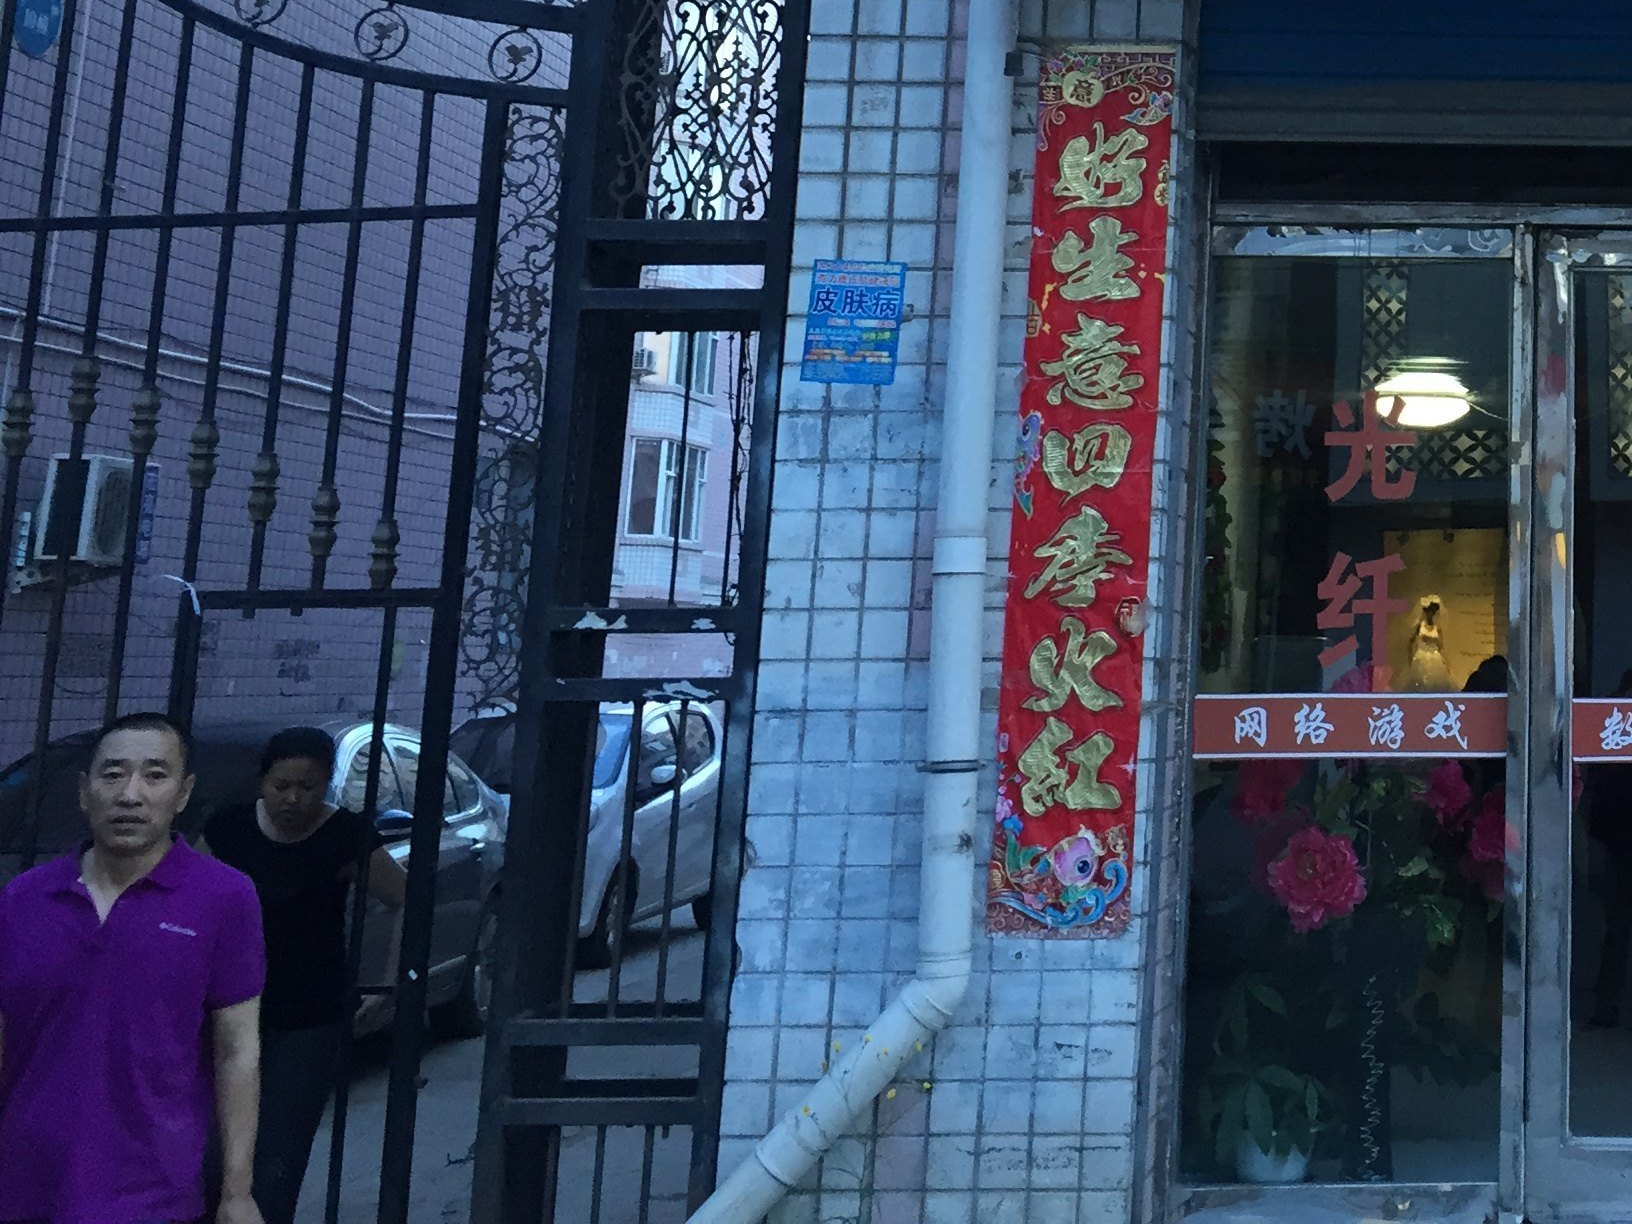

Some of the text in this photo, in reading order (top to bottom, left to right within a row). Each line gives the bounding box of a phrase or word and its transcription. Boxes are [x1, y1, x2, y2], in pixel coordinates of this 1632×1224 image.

[812, 286, 900, 318] 皮肤病
[1316, 390, 1417, 690] 光纤
[1234, 700, 1469, 751] 网络游戏
